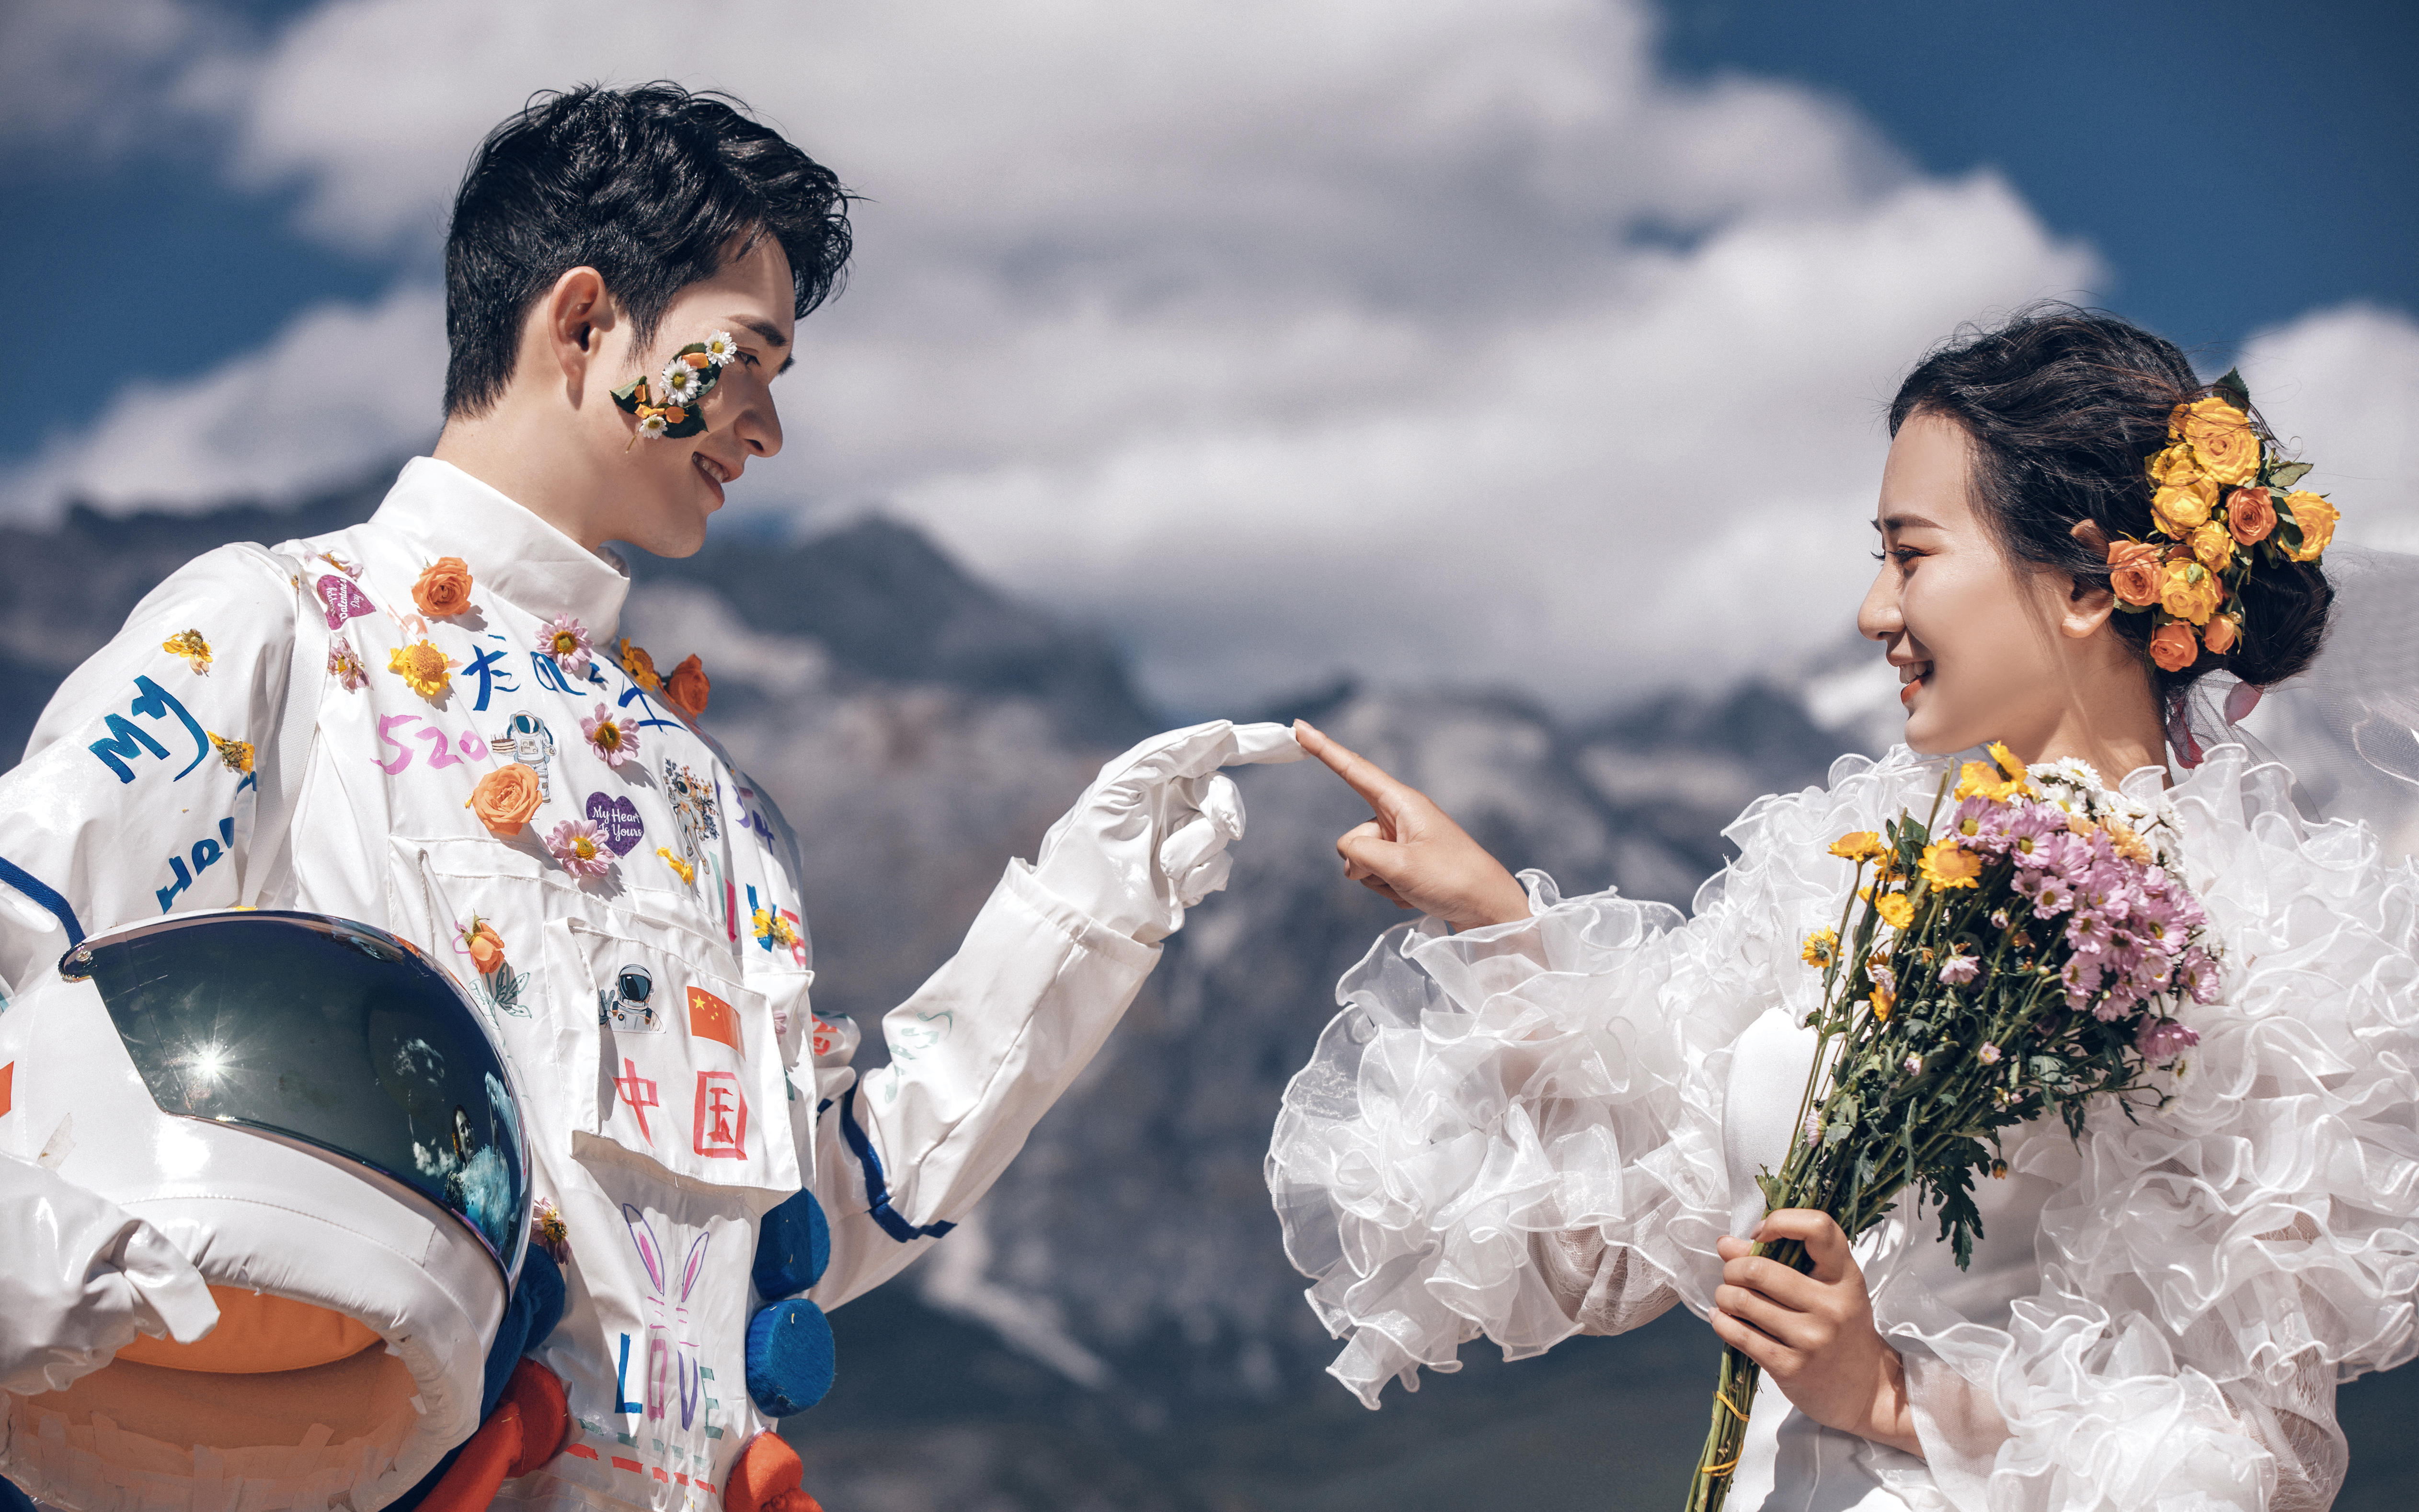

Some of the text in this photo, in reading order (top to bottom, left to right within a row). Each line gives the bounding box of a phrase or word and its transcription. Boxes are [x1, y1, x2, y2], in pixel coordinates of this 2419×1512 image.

[337, 578, 348, 622] Valentine's
[350, 593, 364, 608] Day
[88, 675, 209, 784] My
[369, 713, 488, 775] 520
[592, 805, 640, 824] My Heart
[611, 824, 642, 842] Yours
[612, 1056, 748, 1161] 中国
[615, 1332, 724, 1440] LOVE
